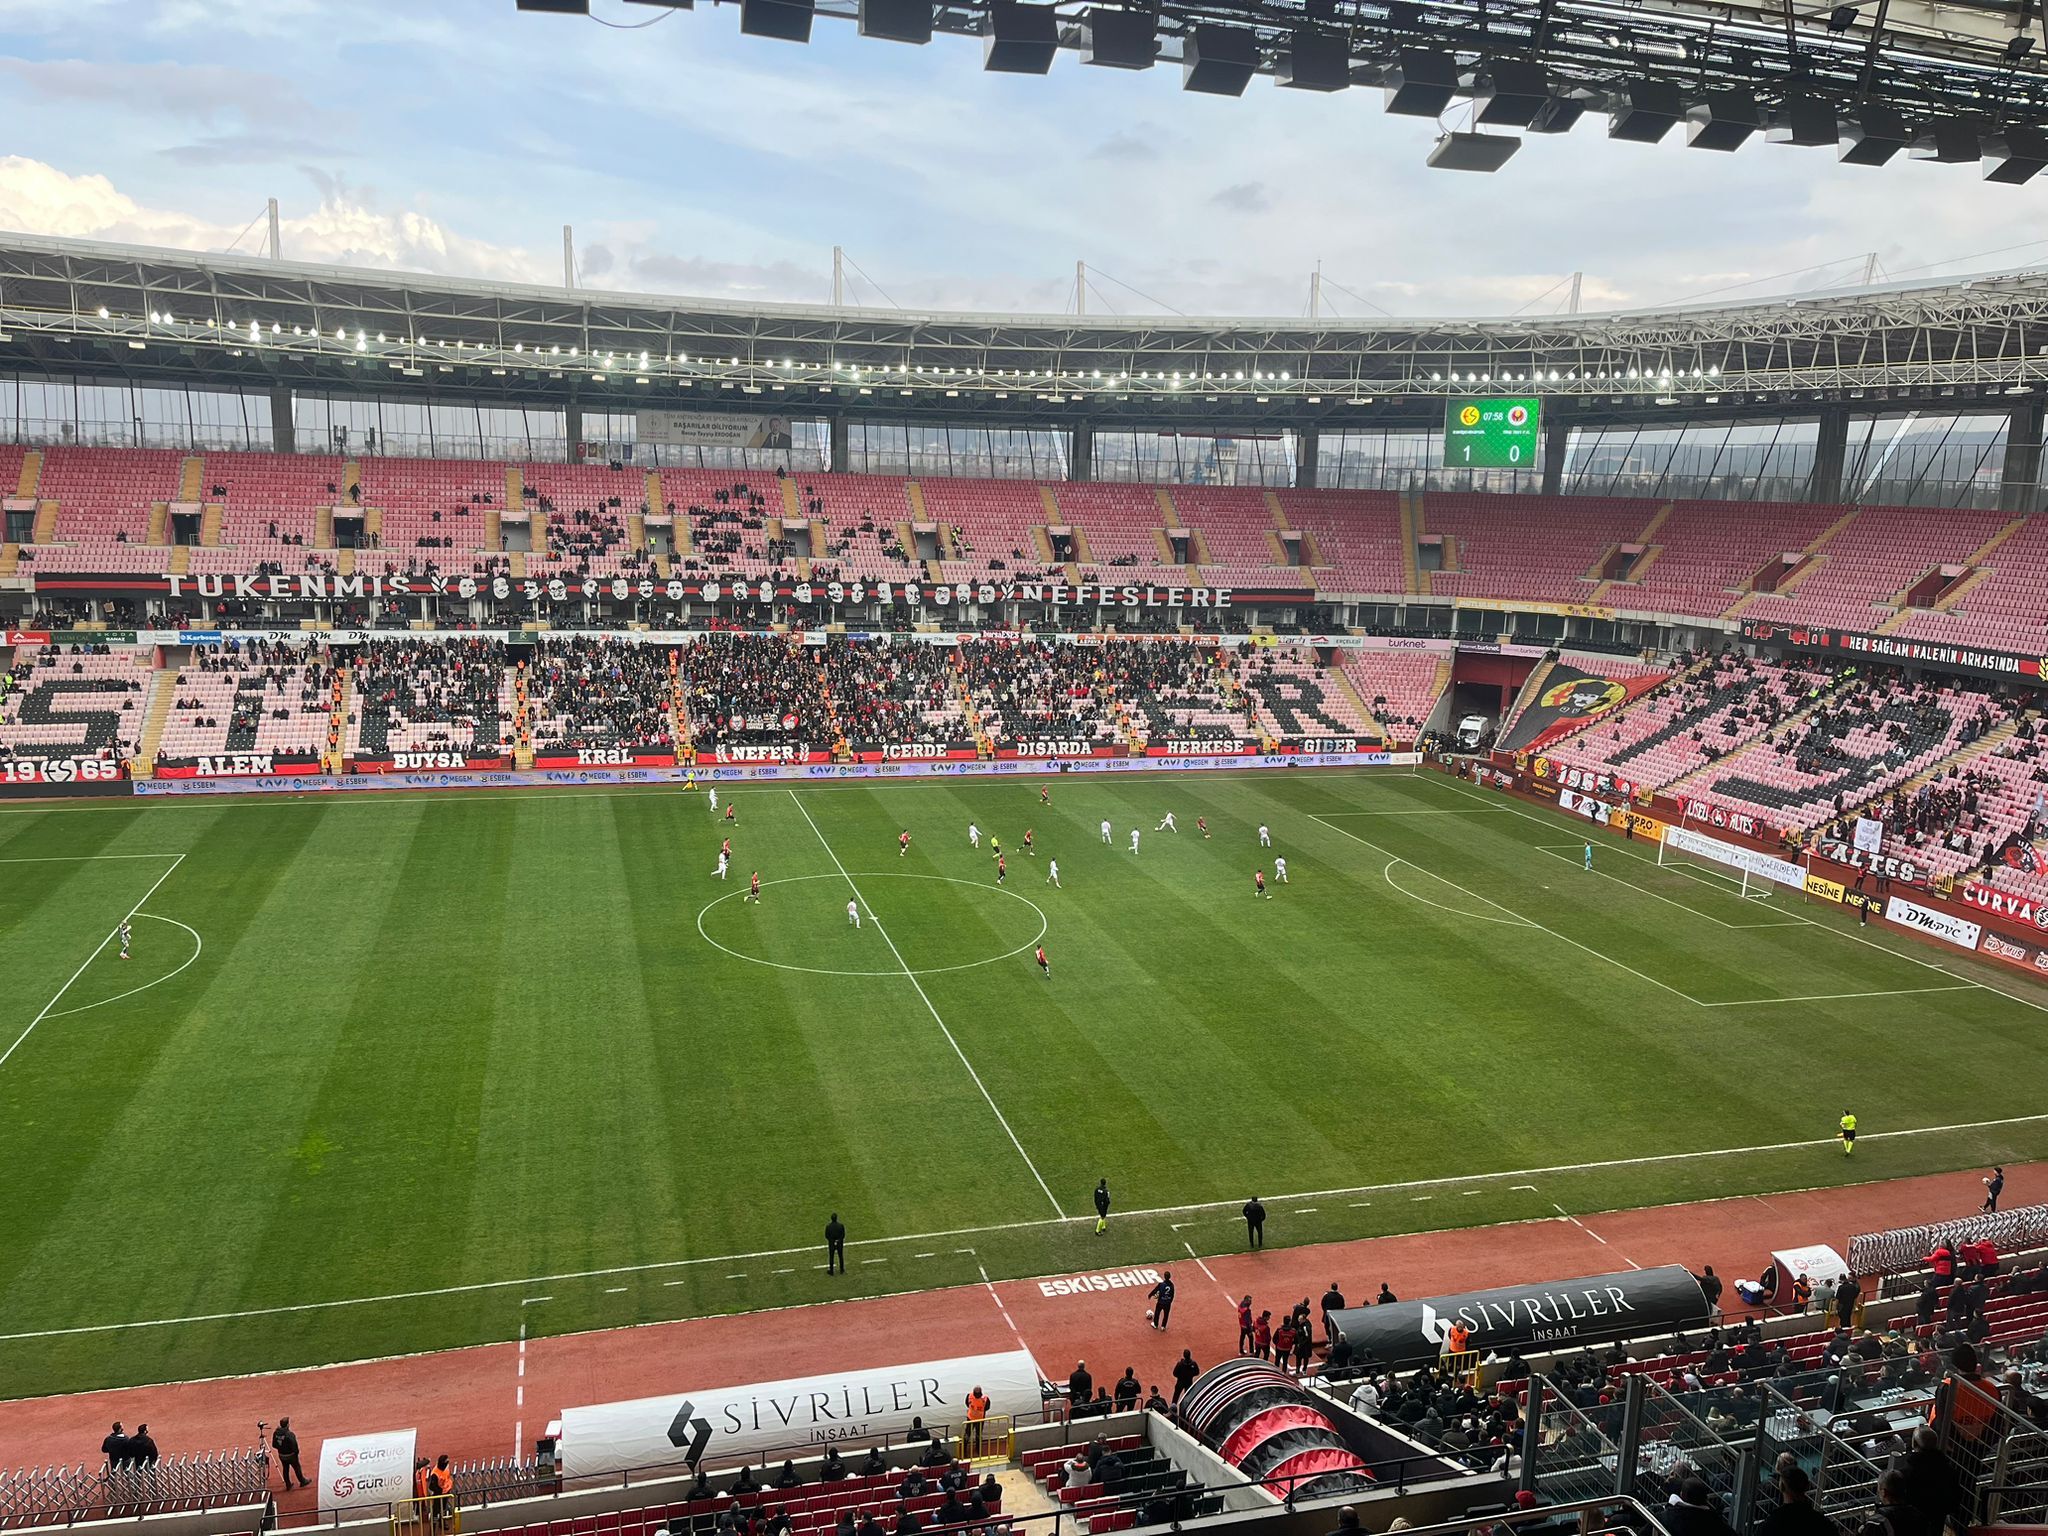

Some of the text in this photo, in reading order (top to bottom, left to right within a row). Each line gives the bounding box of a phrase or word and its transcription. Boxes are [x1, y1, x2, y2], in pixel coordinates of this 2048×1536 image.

[1463, 445, 1471, 462] 1
[1509, 445, 1520, 462] 0
[1022, 585, 1232, 608] NEFESLERE
[1388, 638, 1426, 649] turknet
[1849, 636, 1868, 652] HER
[1871, 638, 1909, 658] SAĞLAM
[731, 745, 796, 761] NEFER
[881, 743, 948, 760] İÇERDE
[1017, 741, 1094, 757] DIŞARDA
[1166, 739, 1245, 754] HERKESE
[1304, 738, 1357, 753] GİDER
[196, 756, 276, 776] ALEM
[394, 752, 466, 769] BUYSA
[147, 782, 173, 790] MEGEM
[303, 778, 328, 787] MEGEM
[588, 772, 611, 780] MEGEM
[720, 769, 743, 777] MEGEM
[1830, 843, 1916, 882] ALTES
[1807, 881, 1840, 899] NESİNE
[1845, 893, 1882, 914] NESNE
[1963, 881, 2031, 921] CURVA
[1037, 1268, 1165, 1298] ESKİŞEHİR
[1458, 1283, 1636, 1334] SİVRİLER
[1532, 1325, 1578, 1341] İNŞAAT
[723, 1377, 948, 1435] SİVRİLER
[809, 1423, 869, 1443] İNŞAAT
